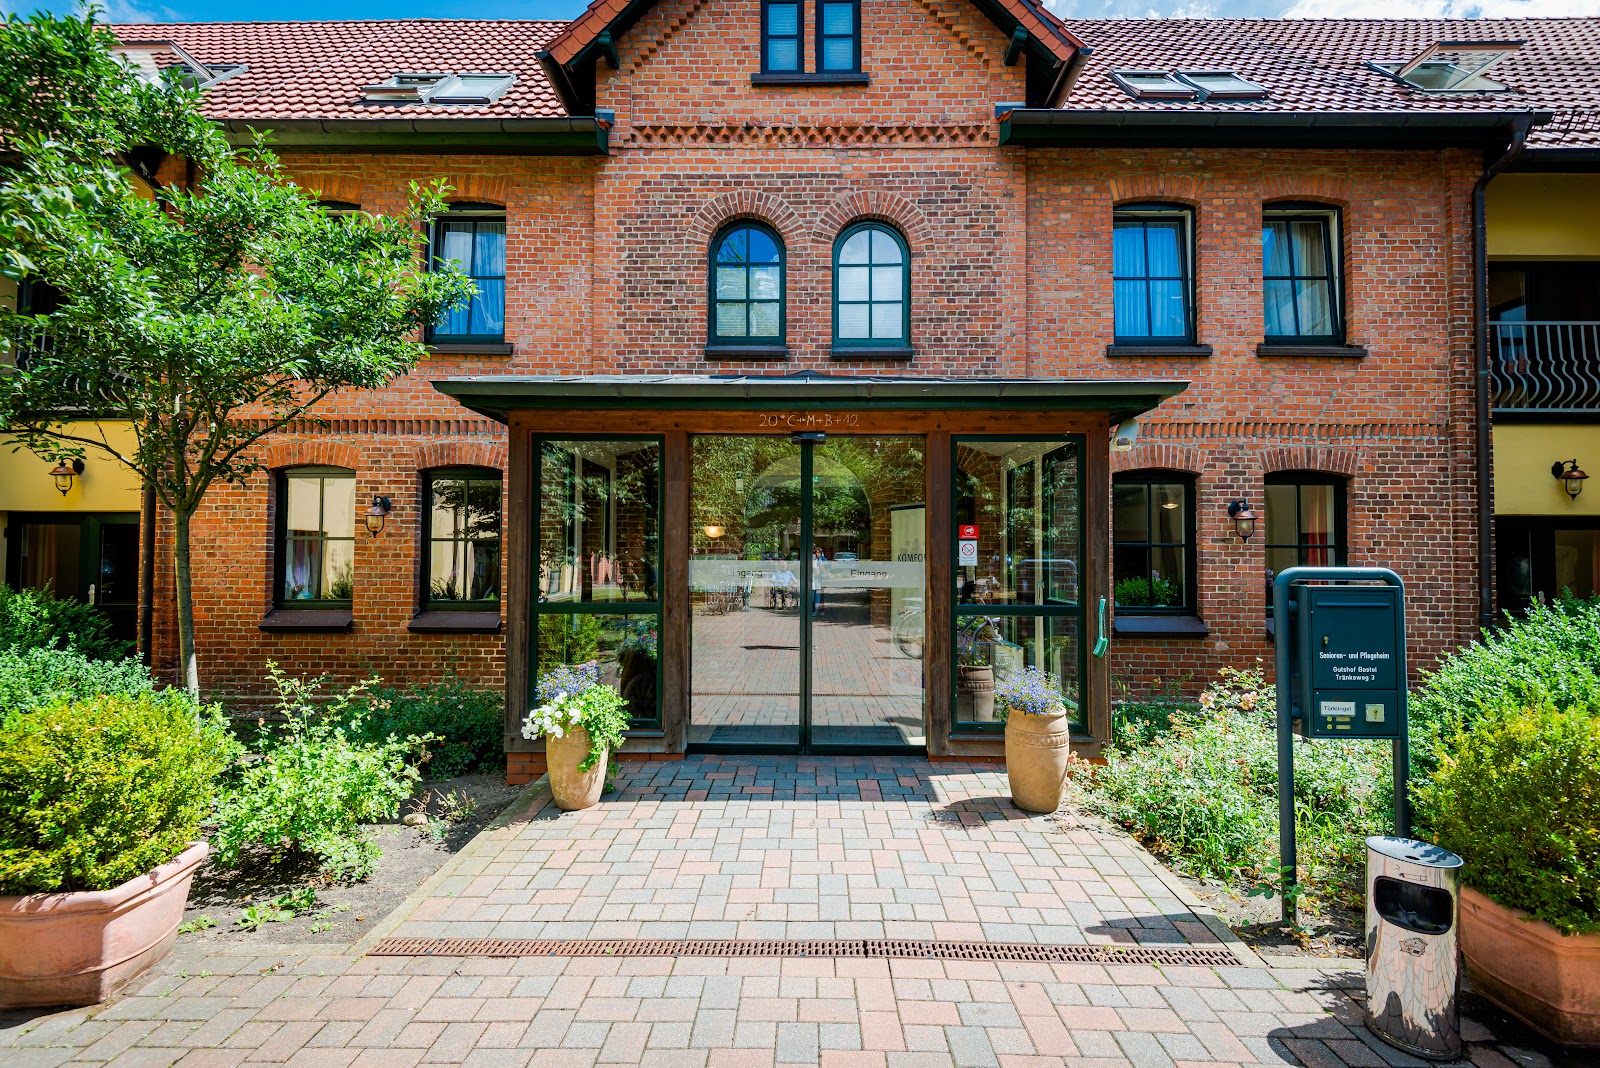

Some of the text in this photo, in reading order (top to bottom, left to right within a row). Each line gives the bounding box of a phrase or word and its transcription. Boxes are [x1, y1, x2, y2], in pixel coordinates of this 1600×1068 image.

[850, 569, 888, 579] Eingang
[1319, 651, 1390, 661] Senioren- und Pflegeheim
[1332, 666, 1357, 674] Gutshof
[1335, 673, 1370, 682] Tränkeweg
[1323, 705, 1352, 713] Türklingel
